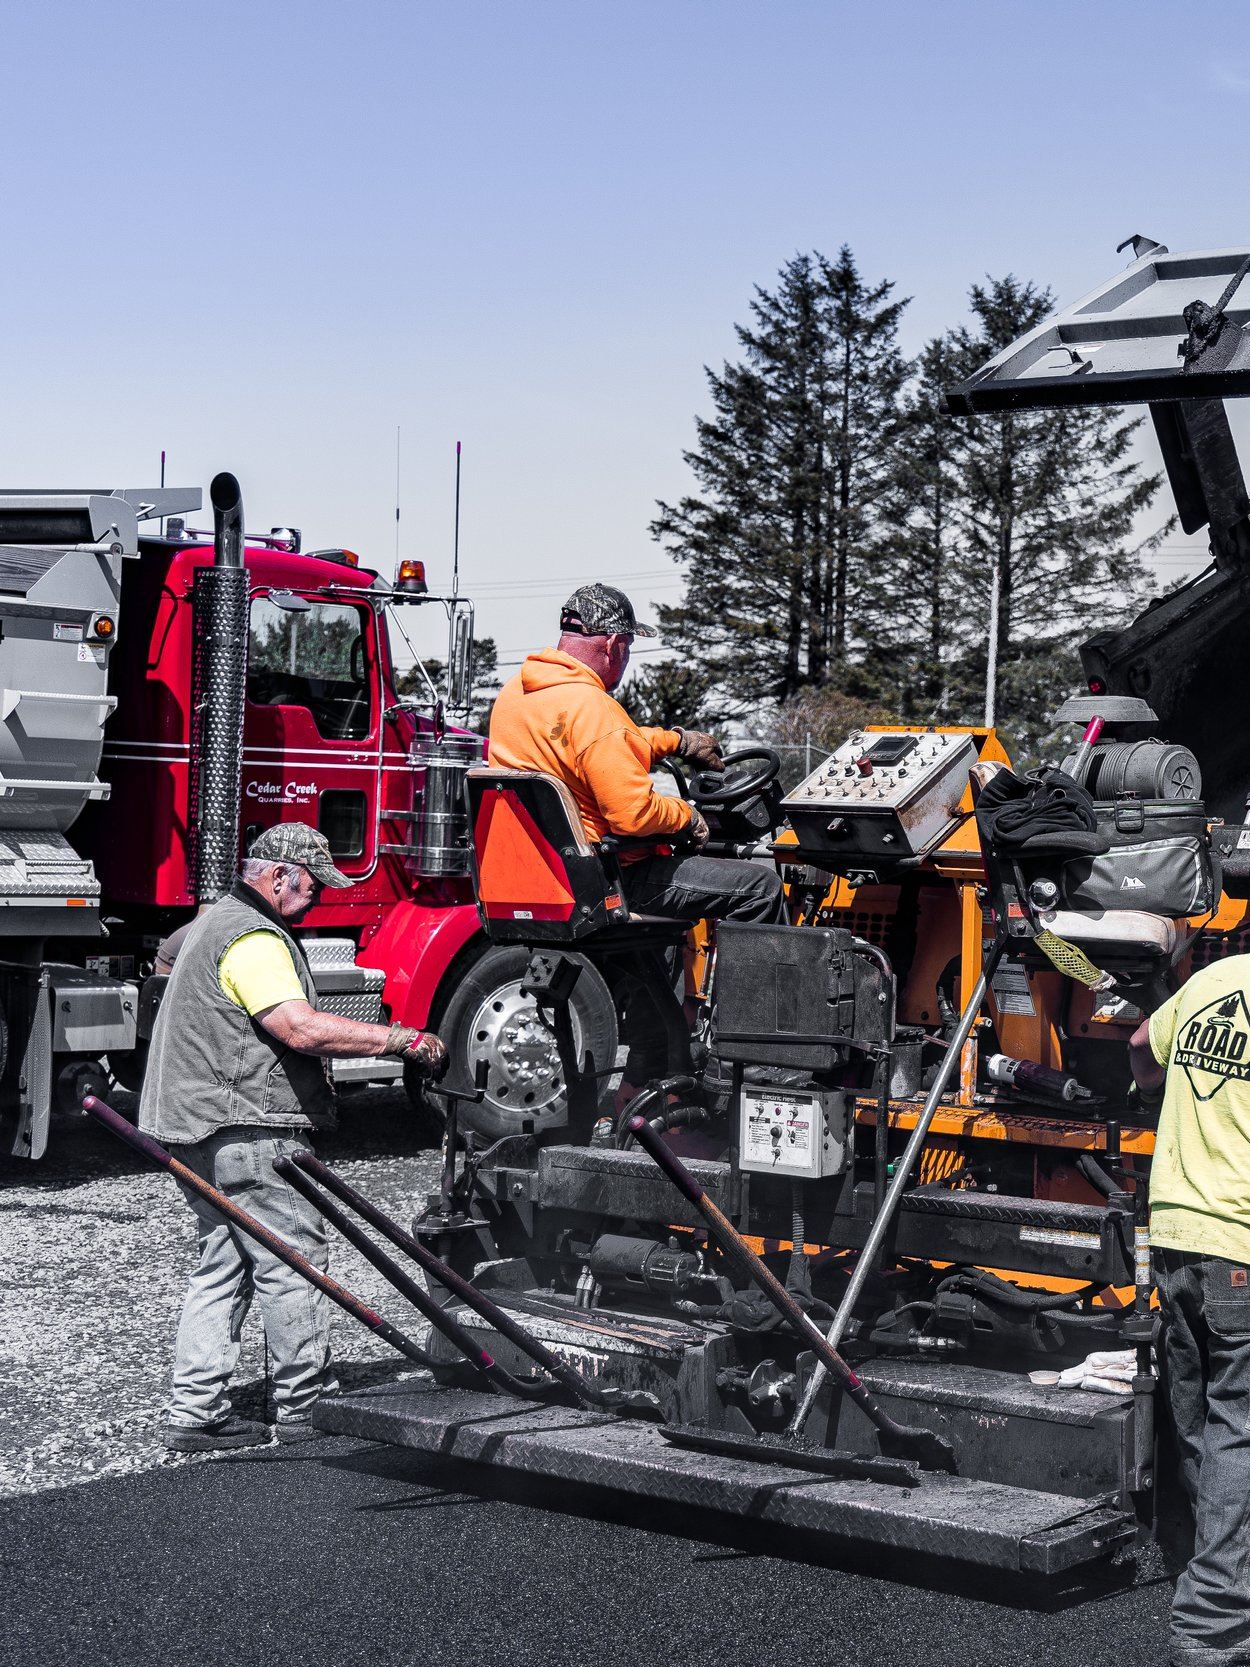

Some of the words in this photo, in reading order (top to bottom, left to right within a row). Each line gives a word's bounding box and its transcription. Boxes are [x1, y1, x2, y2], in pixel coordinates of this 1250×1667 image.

[246, 781, 282, 797] Cedar
[285, 781, 318, 798] Creek
[1184, 1021, 1248, 1060] ROAD
